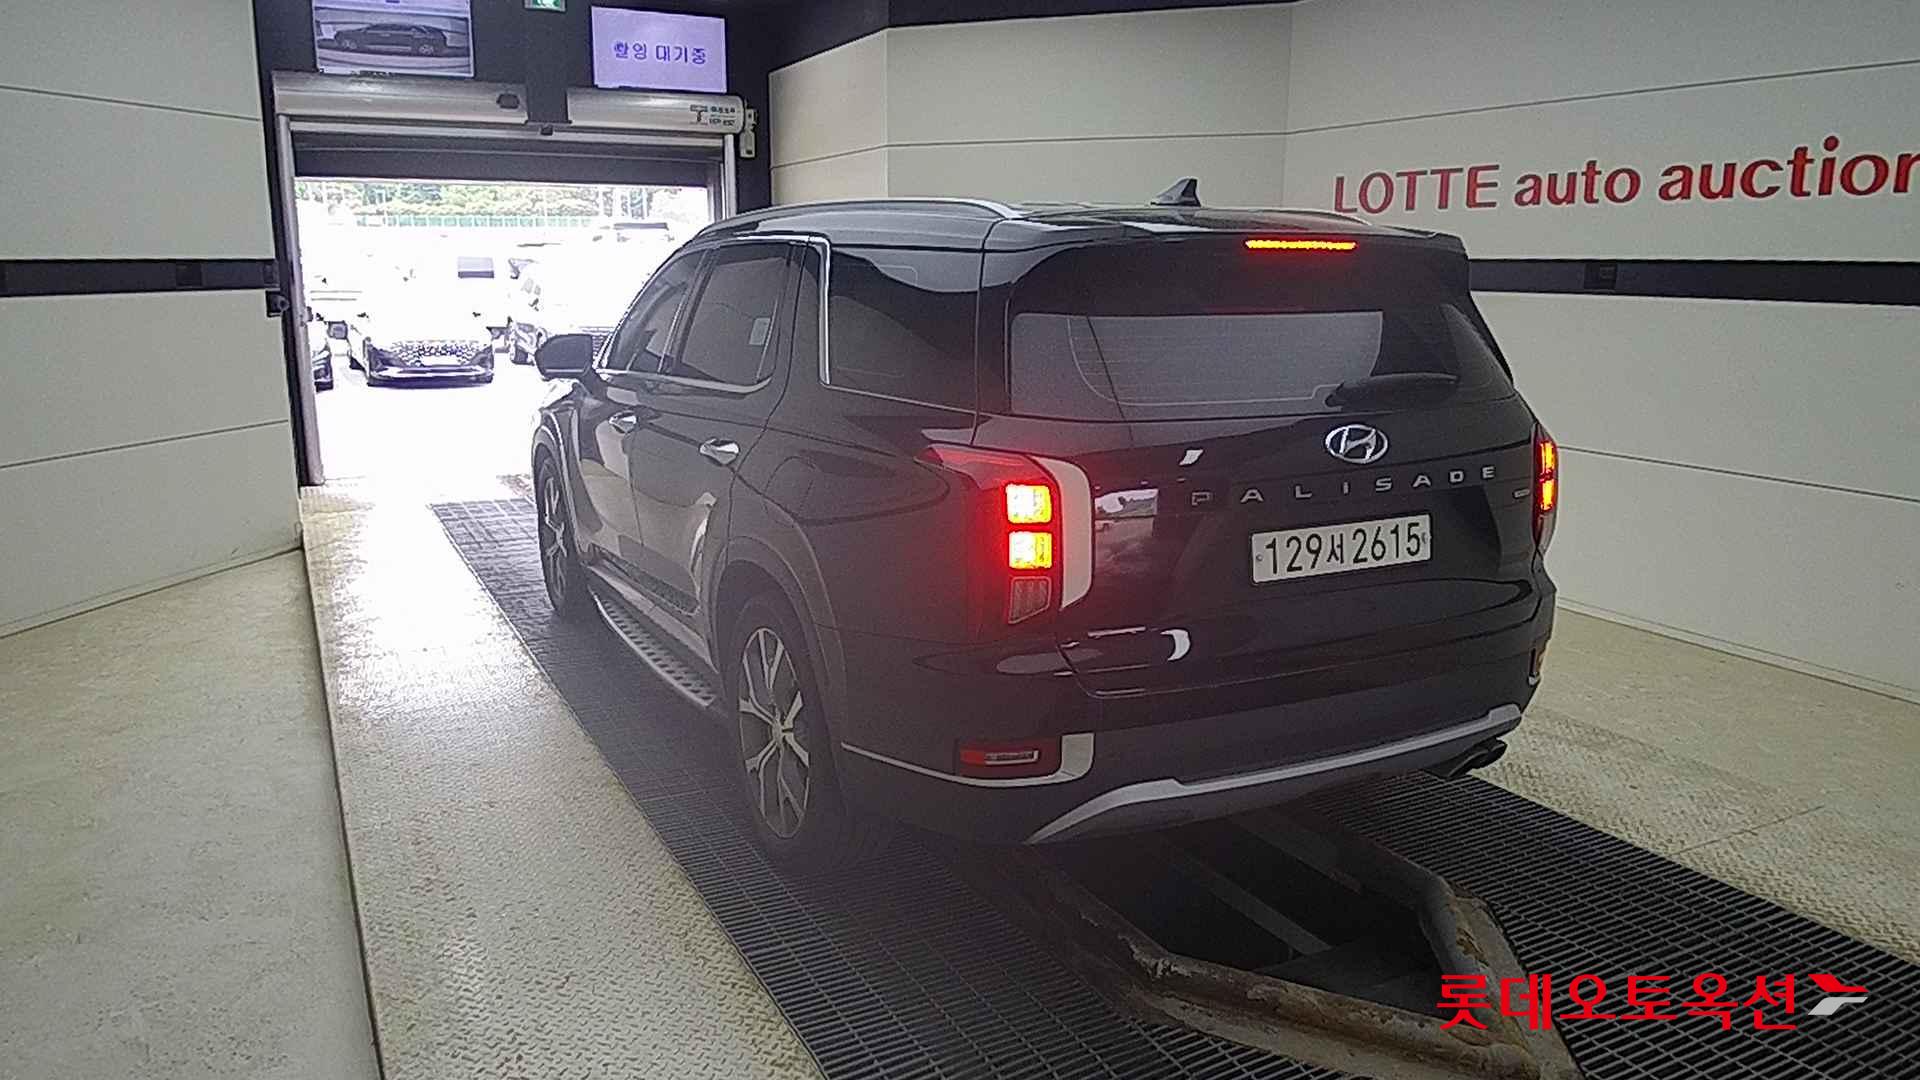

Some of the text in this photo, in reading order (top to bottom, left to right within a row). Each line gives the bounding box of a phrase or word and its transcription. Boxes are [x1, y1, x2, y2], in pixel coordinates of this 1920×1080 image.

[655, 45, 706, 65] 대기중
[1334, 164, 1500, 214] LOTTE
[1513, 160, 1641, 206] auto
[1191, 465, 1496, 505] PALISADE
